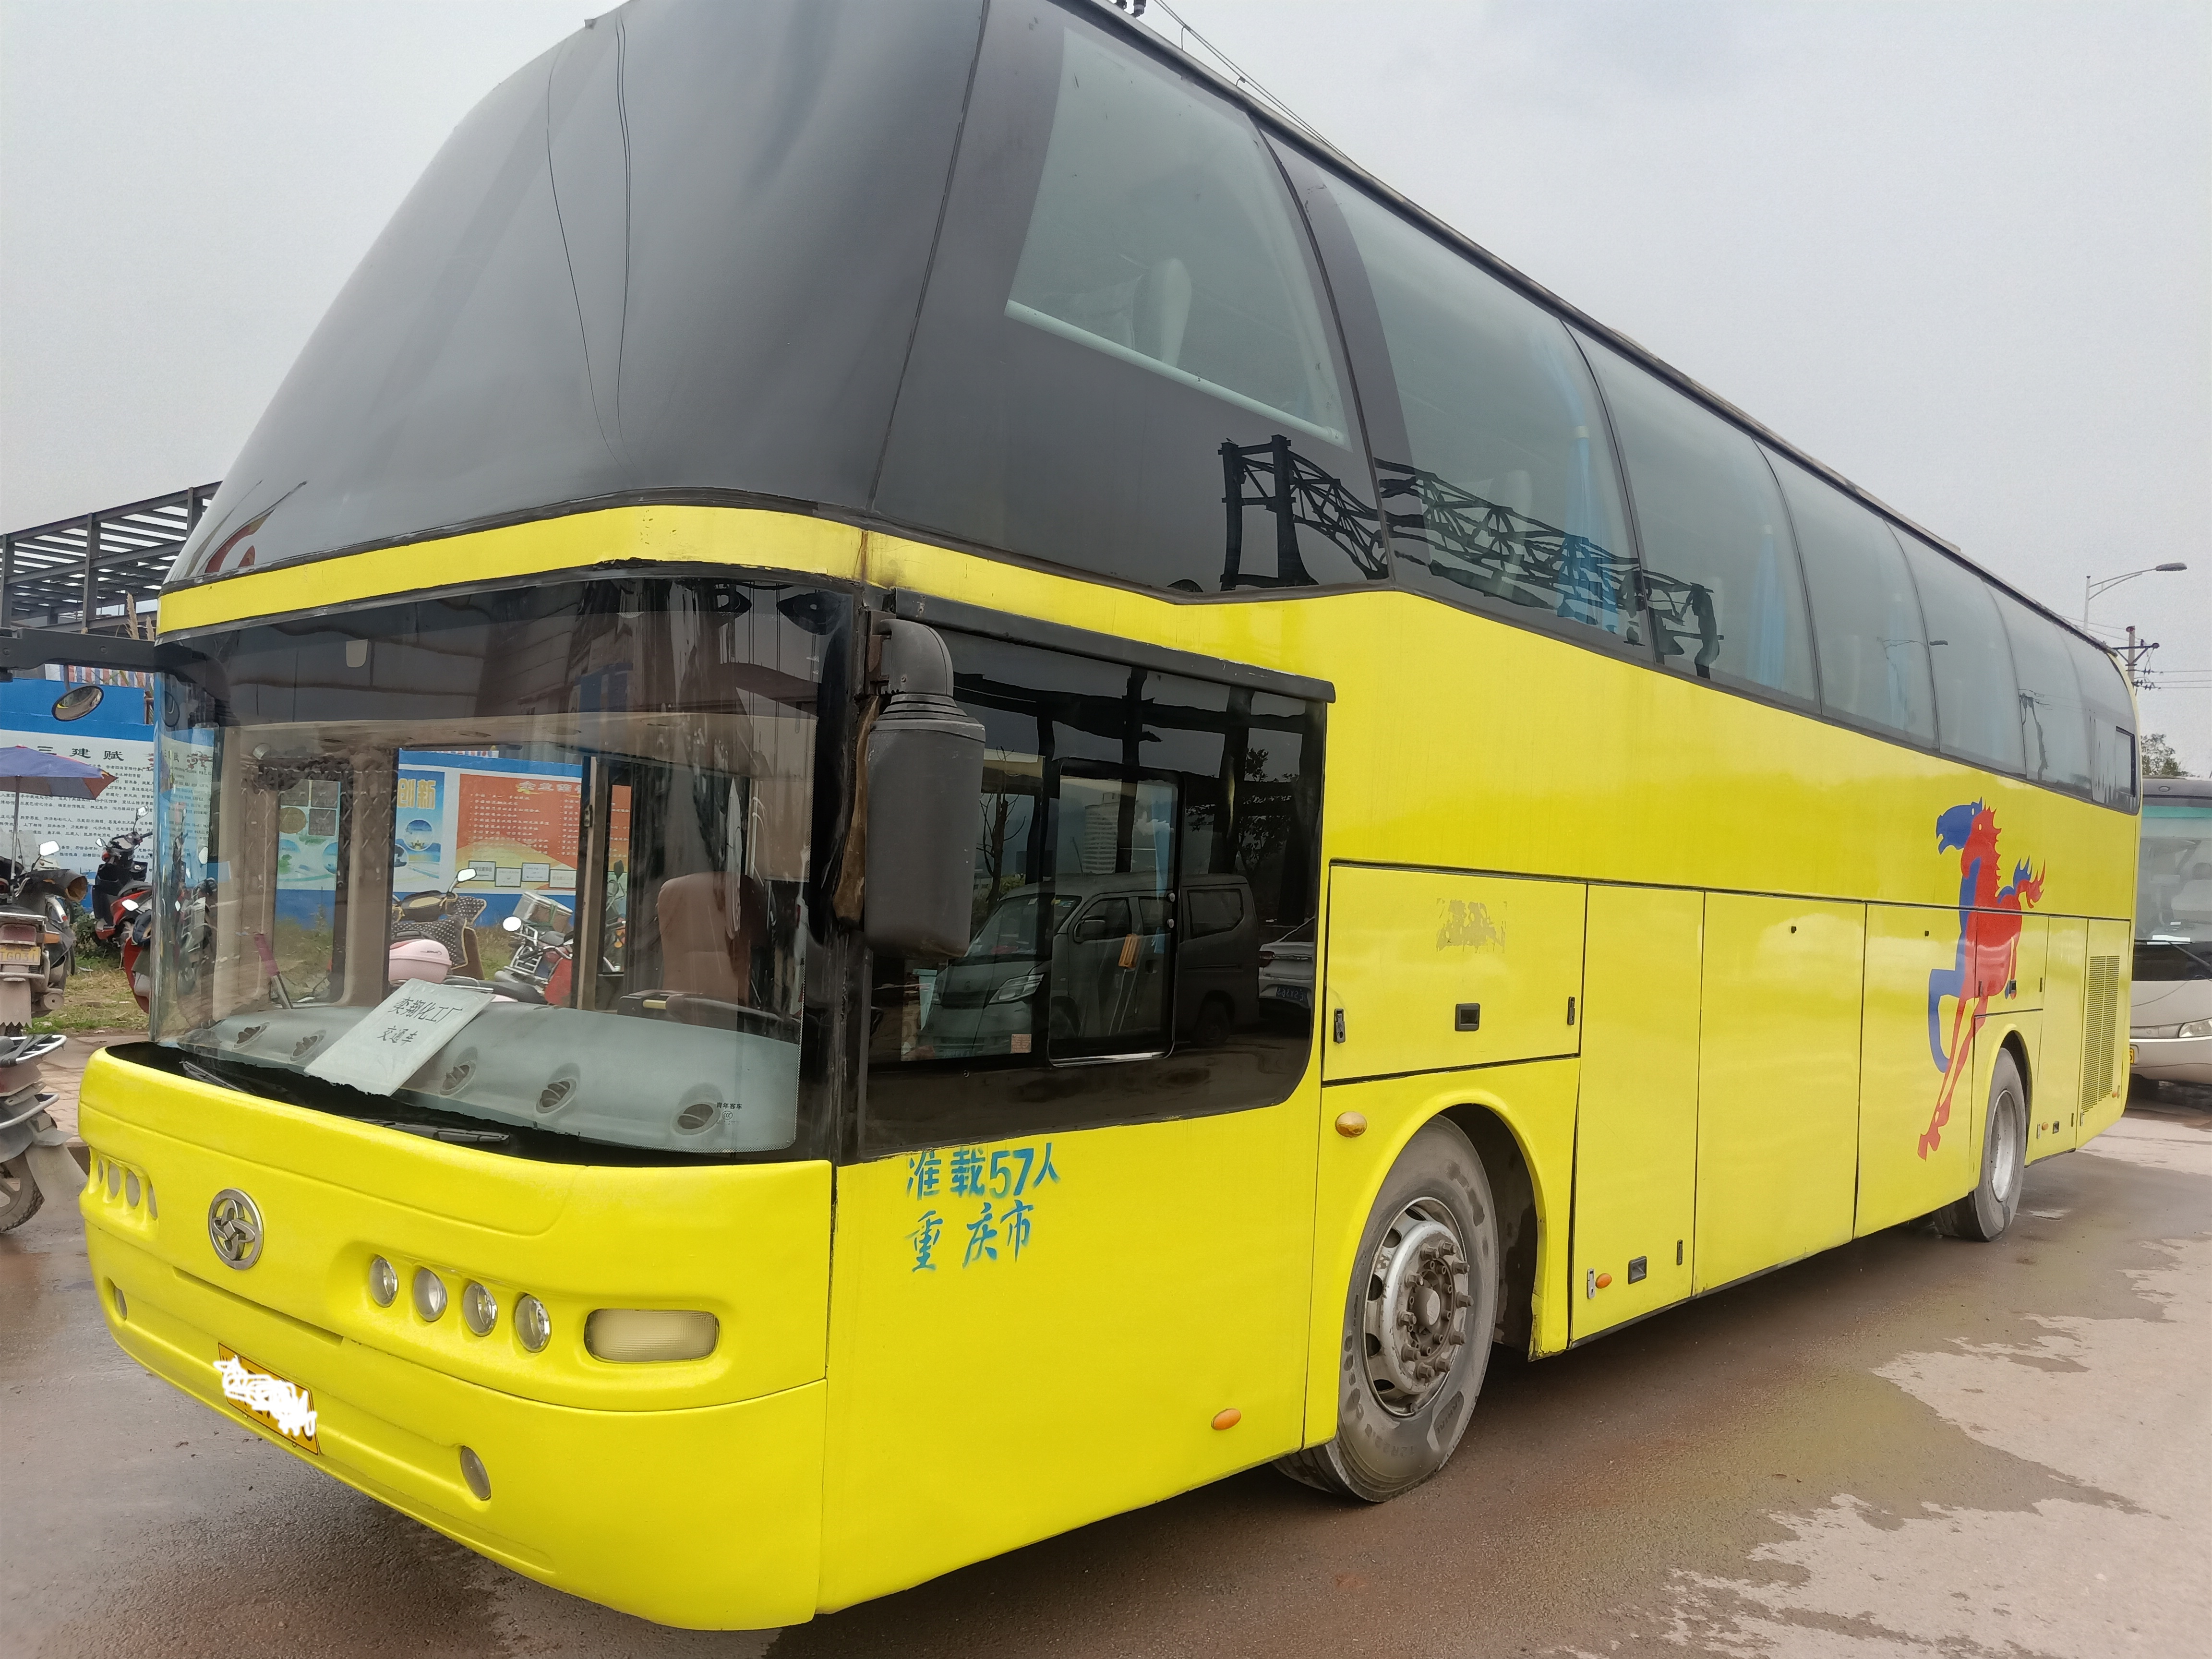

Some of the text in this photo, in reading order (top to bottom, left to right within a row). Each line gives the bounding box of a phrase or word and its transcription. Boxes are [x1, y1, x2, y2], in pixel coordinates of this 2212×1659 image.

[397, 778, 436, 809] 创新
[387, 996, 463, 1023] 奕翔化工厂
[377, 1025, 418, 1045] 交通车
[906, 1199, 1034, 1273] 重庆市
